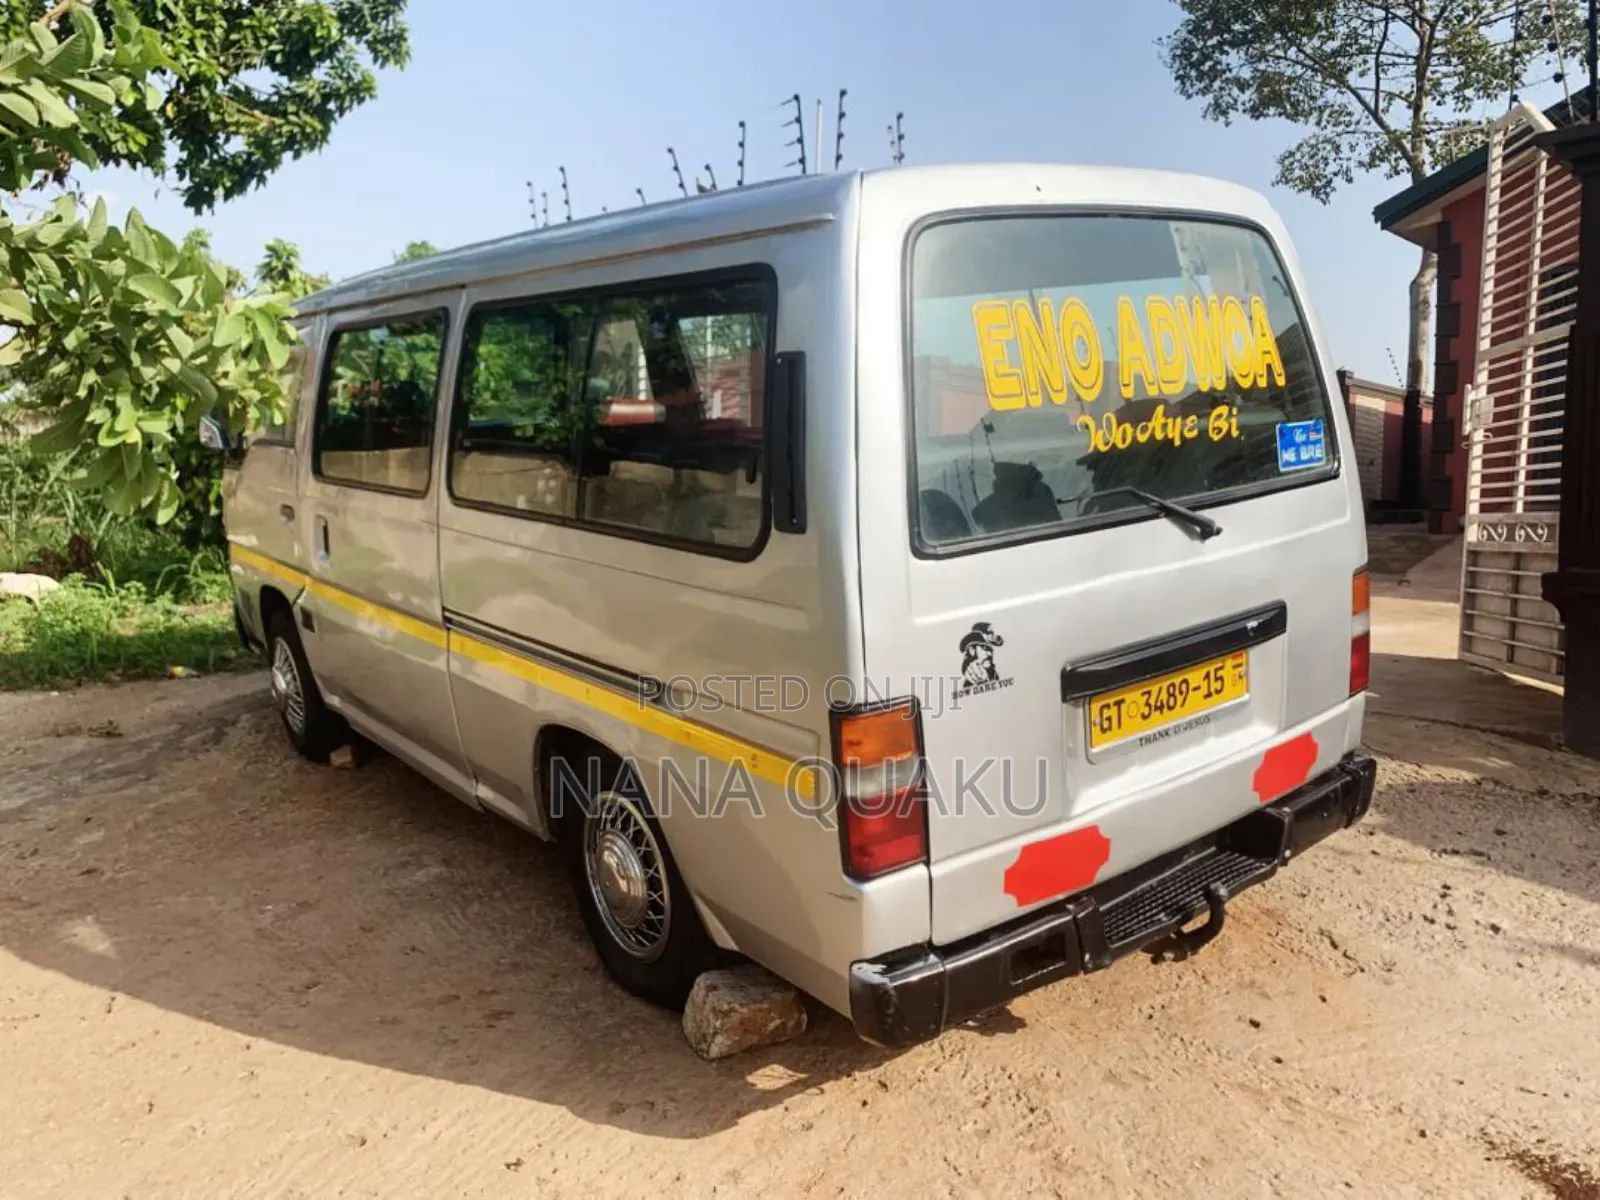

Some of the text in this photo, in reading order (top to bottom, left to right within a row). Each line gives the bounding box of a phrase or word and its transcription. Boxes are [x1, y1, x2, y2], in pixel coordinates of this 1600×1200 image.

[972, 295, 1287, 411] ENO ADWOA
[1099, 663, 1226, 735] GT 3489-15
[1138, 727, 1170, 748] THANK
